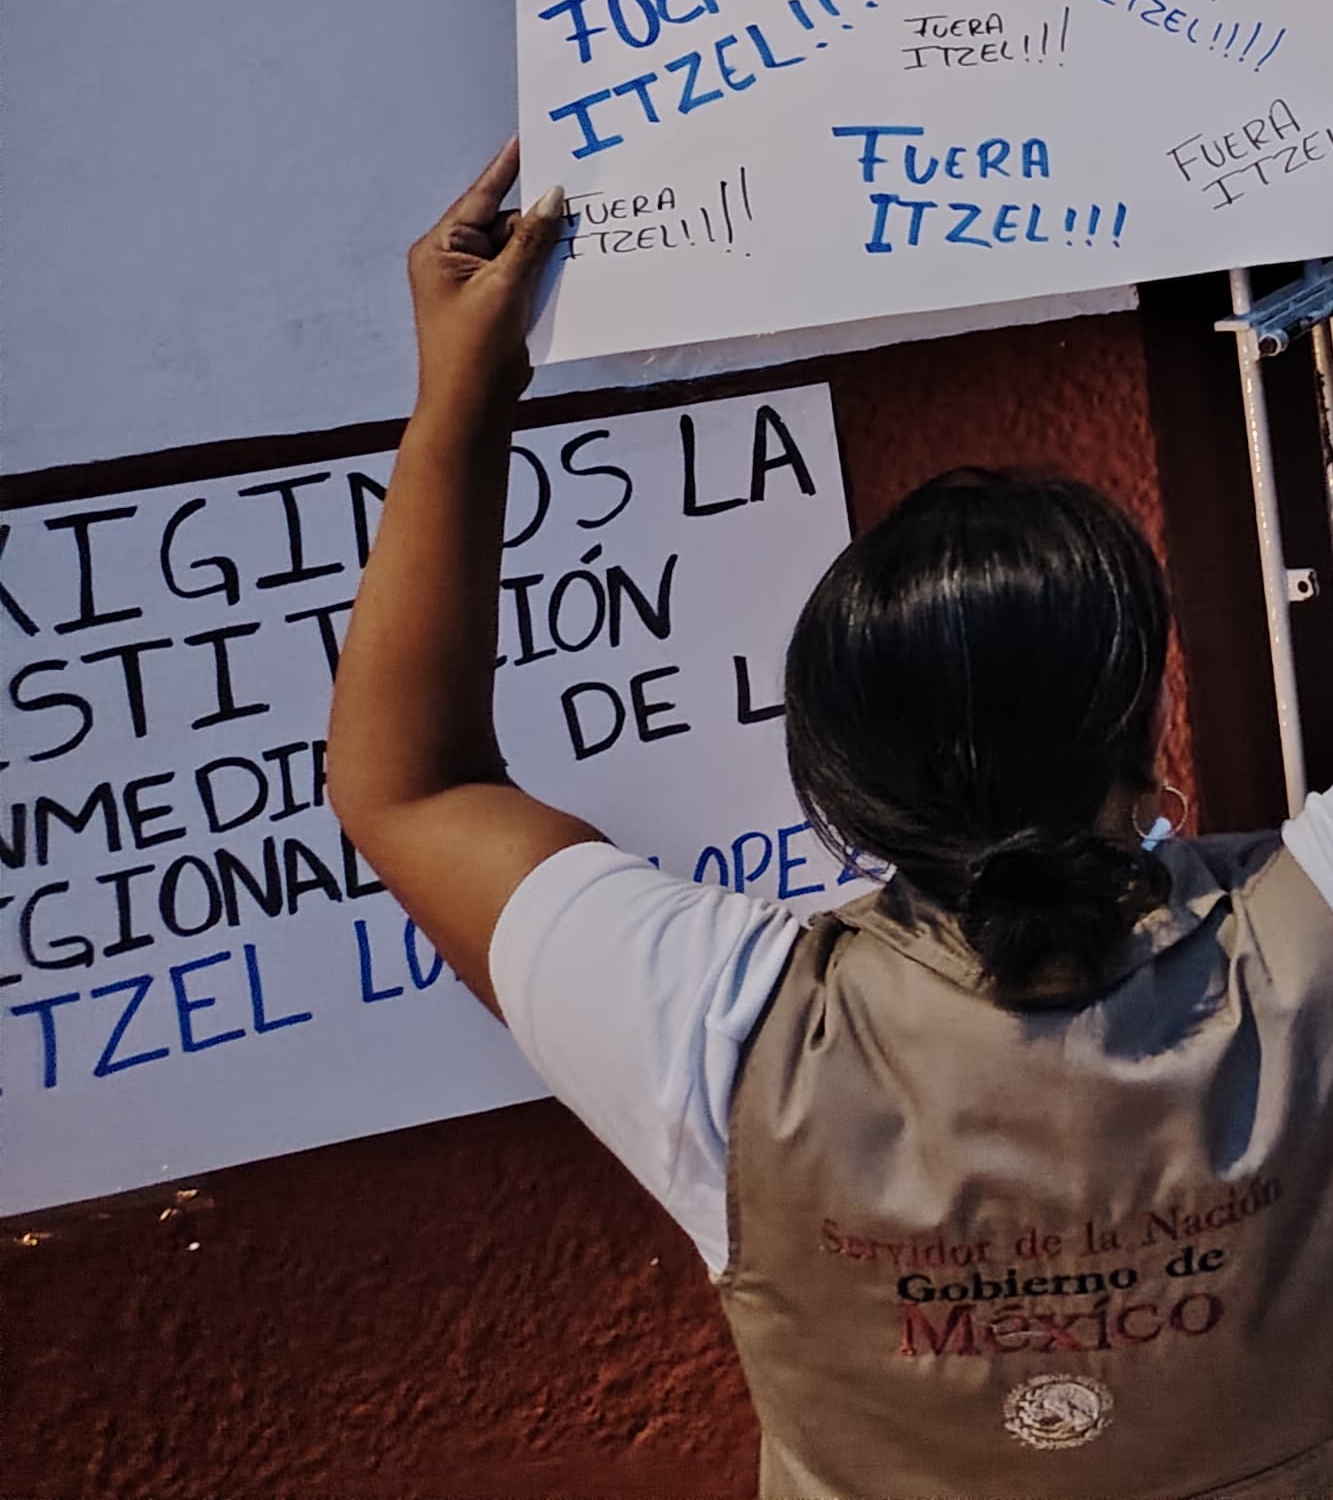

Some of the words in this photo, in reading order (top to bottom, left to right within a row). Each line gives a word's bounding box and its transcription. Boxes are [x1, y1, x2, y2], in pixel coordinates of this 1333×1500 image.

[902, 6, 1071, 71] ITZEL!!!
[903, 10, 1004, 40] FUERA
[831, 125, 1050, 184] FUERA
[1166, 98, 1303, 182] FUERA
[562, 186, 676, 229] FUERA
[864, 193, 1129, 255] ITZEL!!!
[679, 404, 817, 517] LA
[560, 665, 692, 761] DE
[732, 654, 787, 725] L
[0, 828, 388, 987] GIONAL
[0, 943, 313, 1090] TZEL
[820, 1218, 991, 1268] Servidor
[1014, 1227, 1062, 1263] de
[1085, 1221, 1121, 1255] la
[1140, 1176, 1282, 1248] Nación
[896, 1264, 1139, 1304] Gobierno
[1165, 1246, 1227, 1279] de
[898, 1291, 1226, 1358] México
